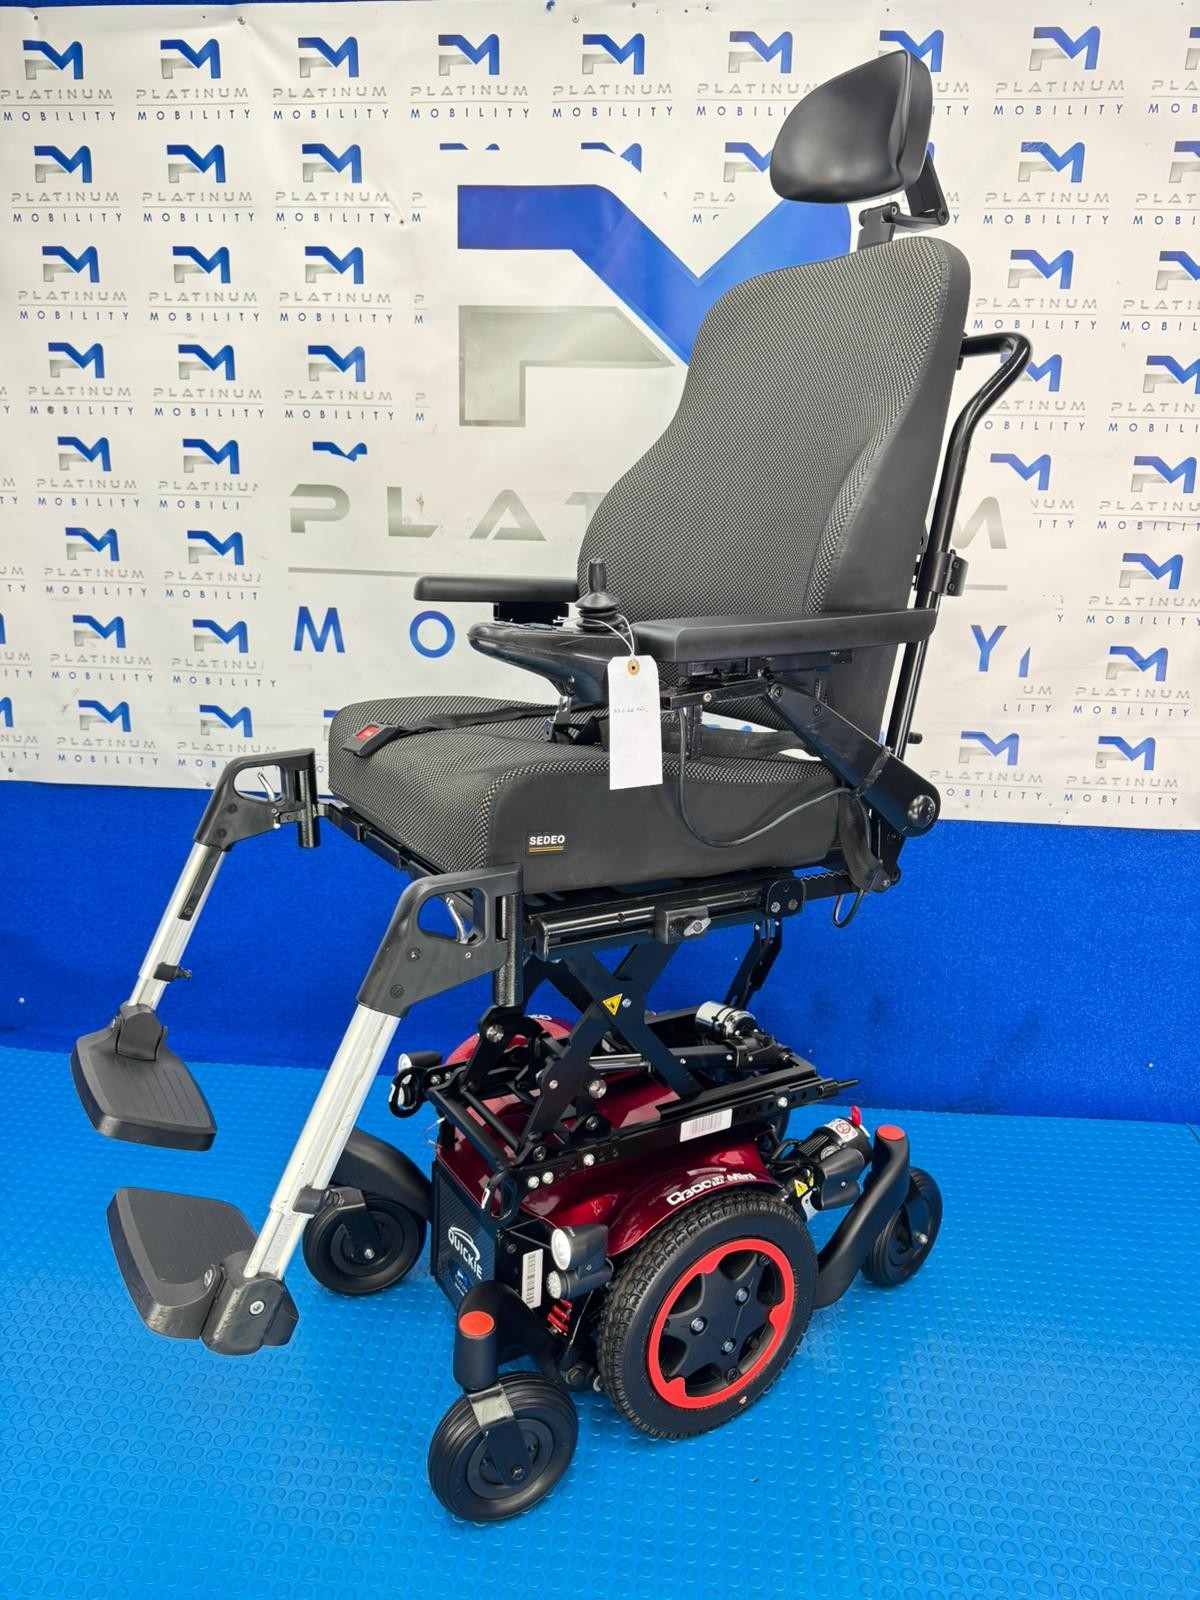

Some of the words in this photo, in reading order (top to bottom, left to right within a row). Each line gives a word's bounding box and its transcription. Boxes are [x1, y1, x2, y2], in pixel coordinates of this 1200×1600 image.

[273, 86, 386, 98] PLATINUM
[411, 85, 528, 96] PLATINUM
[553, 84, 672, 96] PLATINUM
[996, 80, 1124, 93] PLATINUM
[0, 89, 112, 99] PLATINUM
[136, 88, 248, 99] PLATINUM
[138, 109, 250, 120] MOBILITY
[273, 108, 389, 120] MOBILITY
[411, 107, 529, 118] MOBILITY
[552, 105, 672, 118] MOBILITY
[696, 106, 788, 118] MOBILI
[993, 104, 1123, 115] MOBILITY
[4, 111, 115, 123] MOBILITY
[12, 192, 119, 202] PLATINUM
[142, 192, 252, 202] PLATINUM
[275, 191, 389, 202] PLATINUM
[985, 192, 1109, 203] PLATINUM
[13, 213, 122, 223] MOBILITY
[143, 211, 255, 222] MOBILITY
[276, 212, 390, 223] MOBILITY
[983, 214, 1108, 225] MOBILITY
[18, 291, 126, 301] PLATINUM
[149, 292, 257, 302] PLATINUM
[279, 292, 391, 303] PLATINUM
[976, 298, 1097, 309] PLATINUM
[1123, 300, 1200, 310] PLATI
[18, 310, 128, 320] MOBILITY
[150, 312, 259, 322] MOBILITY
[280, 312, 392, 323] MOBILITY
[973, 319, 1097, 330] MOBILITY
[1120, 321, 1197, 333] MOBIL
[28, 386, 131, 396] PLATINUM
[153, 388, 262, 398] PLATINUM
[284, 390, 392, 400] PLATINUM
[155, 408, 264, 418] MOBILITY
[1111, 402, 1195, 413] PLATIN
[285, 410, 393, 420] MOBILITY
[1108, 423, 1198, 433] MOBILI
[37, 479, 136, 488] PLATINUM
[158, 481, 258, 492] PLATINU
[38, 497, 139, 507] MOBILITY
[159, 500, 239, 510] MOBILI
[44, 568, 144, 578] PLATINUM
[164, 571, 261, 582] PLATINU
[46, 586, 147, 596] MOBILITY
[166, 587, 259, 600] MOBILIT
[51, 654, 151, 666] PLATINUM
[172, 658, 264, 671] PLATINU
[52, 669, 153, 682] MOBILITY
[173, 674, 276, 687] MOBILITY
[1075, 687, 1190, 699] PLATINUM
[1073, 704, 1190, 717] MOBILITY
[57, 737, 156, 750] PLATINUM
[58, 752, 158, 765] MOBILITY
[929, 770, 1042, 784] PLATINUM
[1066, 776, 1178, 789] PLATINUM
[1064, 792, 1178, 806] MOBILITY
[529, 834, 566, 846] SEDEO
[448, 1229, 483, 1280] QUICKIE
